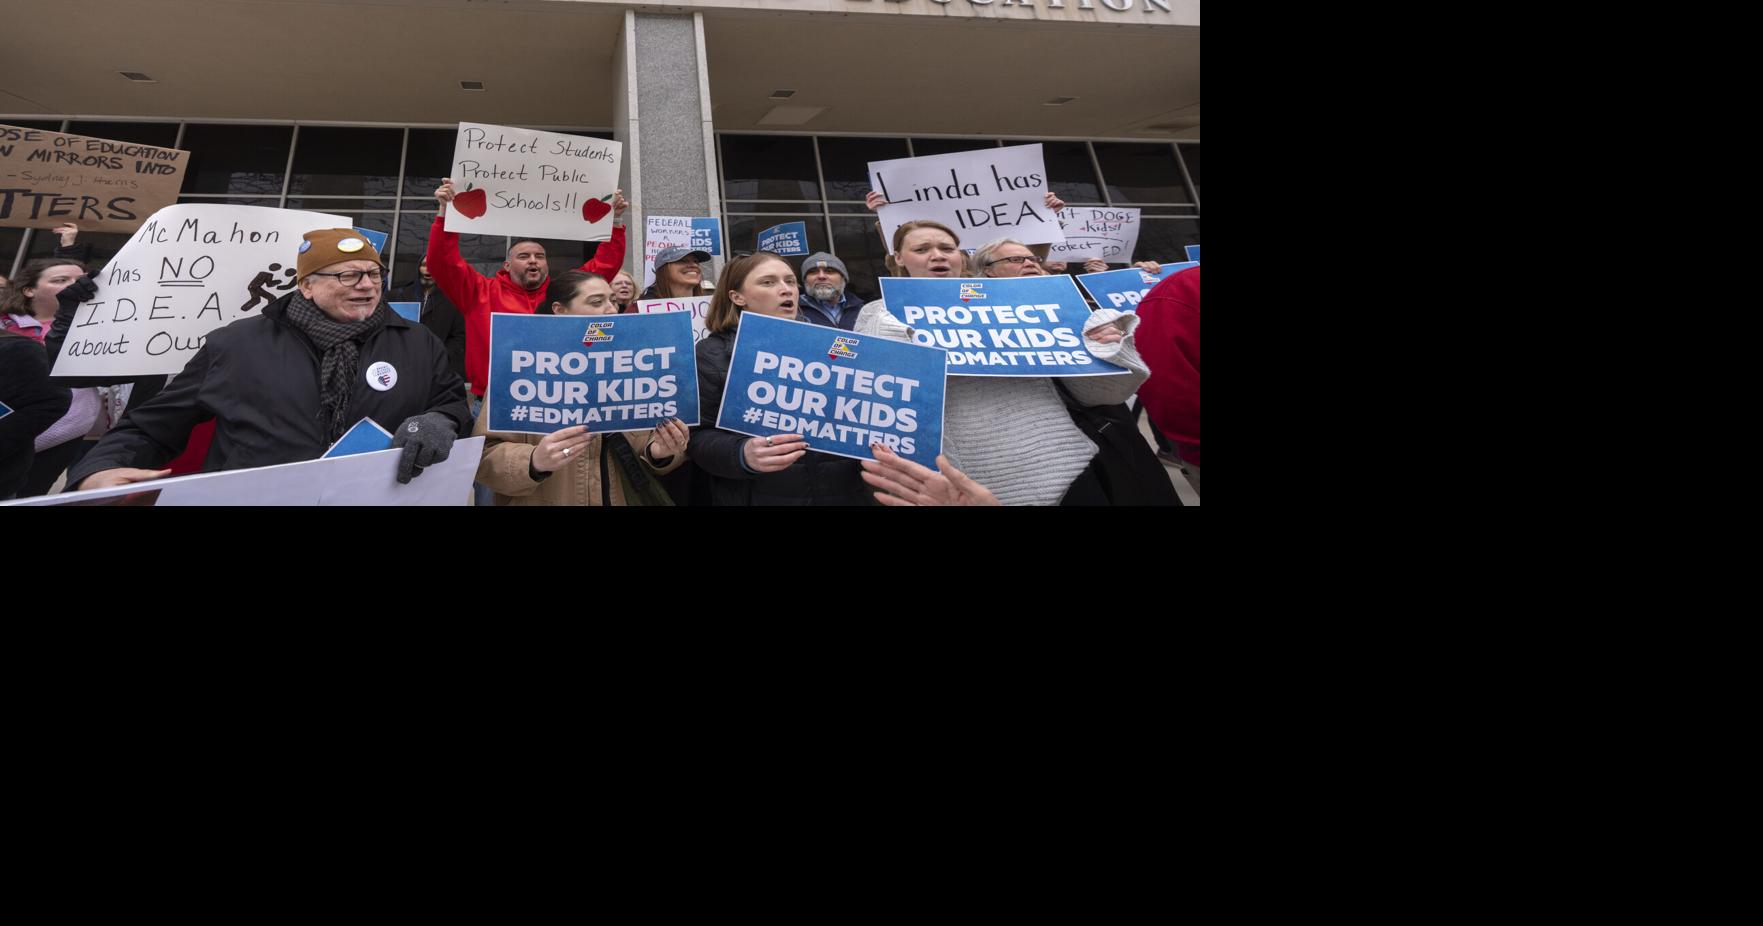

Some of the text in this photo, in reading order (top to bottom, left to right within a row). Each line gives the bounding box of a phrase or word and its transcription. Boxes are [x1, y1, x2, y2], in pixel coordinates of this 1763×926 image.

[54, 137, 81, 147] OF
[86, 140, 179, 161] EDUCATION
[464, 128, 615, 163] Protect Students
[27, 149, 123, 170] MIRRORS
[135, 161, 177, 175] INTO
[459, 160, 590, 183] Protect Public
[876, 164, 1042, 204] Linda has
[491, 191, 577, 214] Schools!!
[648, 218, 691, 227] FEDERAL
[1091, 209, 1135, 223] DOGE
[761, 231, 799, 247] PROTECT
[776, 239, 800, 249] KIDS
[109, 256, 214, 286] has NO
[904, 303, 1060, 325] PROTECT
[68, 334, 129, 356] about
[837, 337, 858, 345] COLOR
[912, 327, 1081, 348] OUR KIDS
[511, 347, 676, 375] PROTECT
[830, 349, 856, 358] CHANGE
[753, 351, 920, 402] PROTECT
[509, 375, 678, 405] OUR KIDS
[511, 401, 678, 425] #EDMATTERS
[747, 381, 918, 433] OUR KIDS
[742, 407, 916, 455] #EDMATTERS
